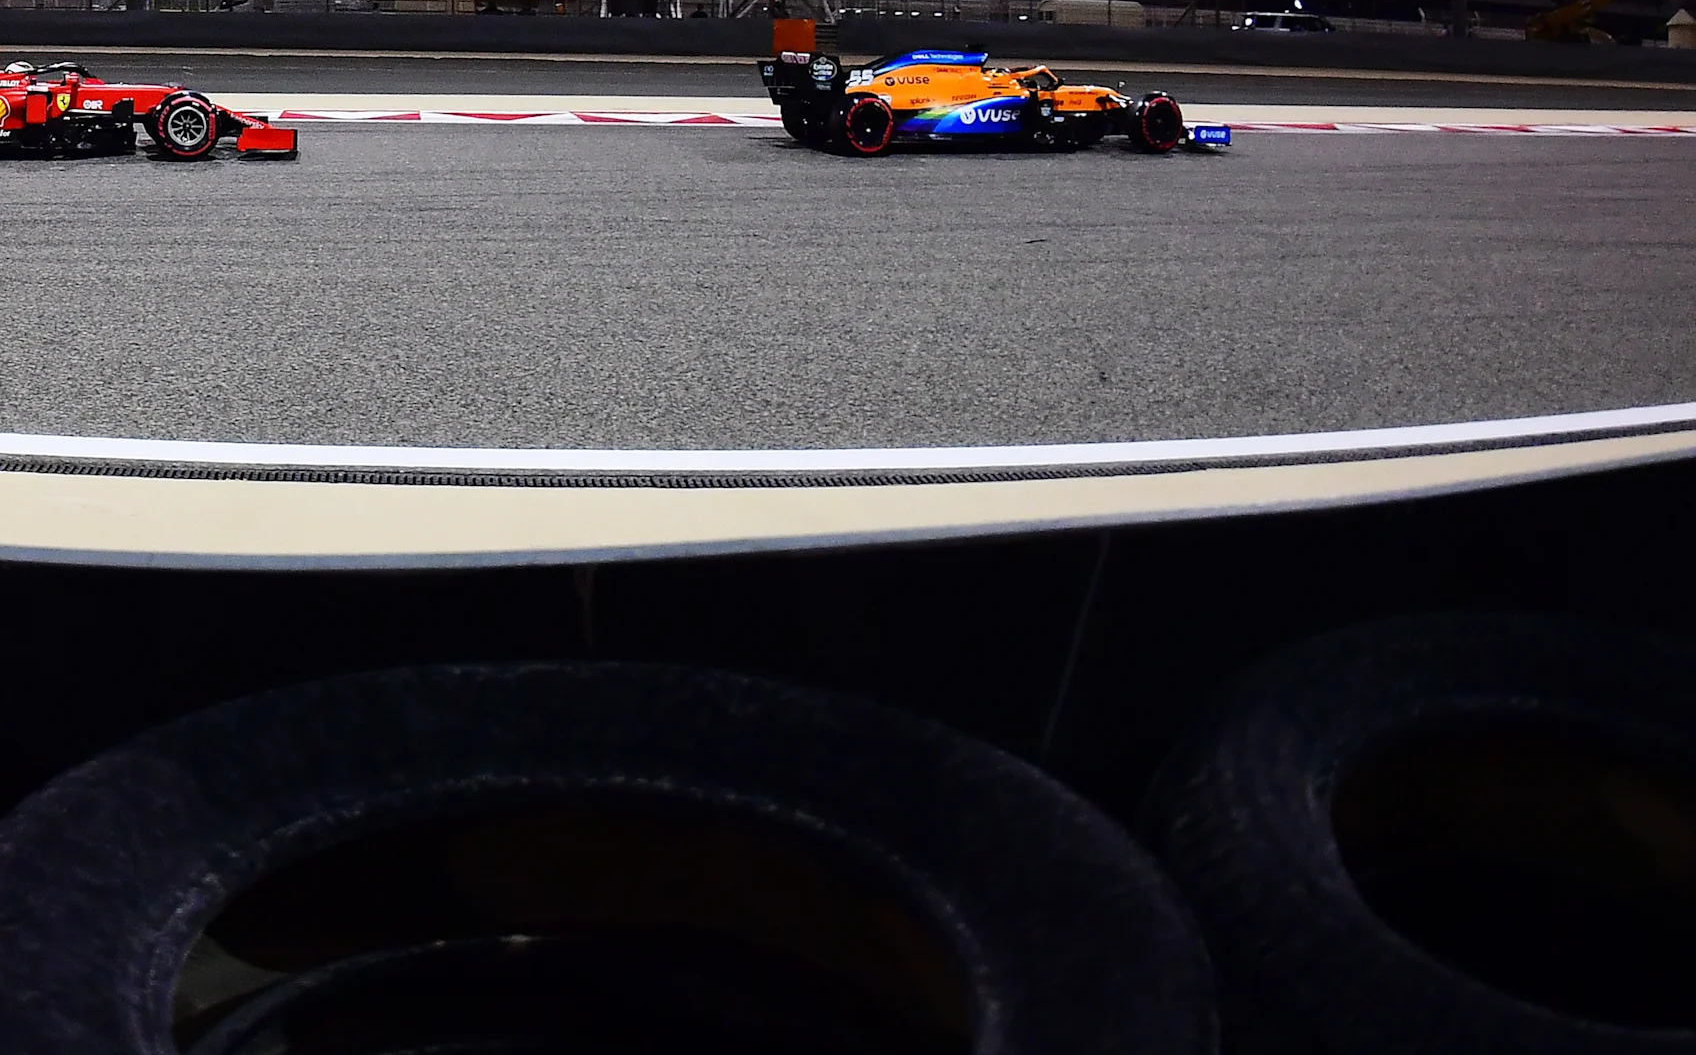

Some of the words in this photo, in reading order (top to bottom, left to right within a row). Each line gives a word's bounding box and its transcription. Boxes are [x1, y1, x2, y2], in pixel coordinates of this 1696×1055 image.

[845, 69, 874, 86] 55
[897, 76, 930, 85] vuse
[977, 109, 1021, 123] vuse
